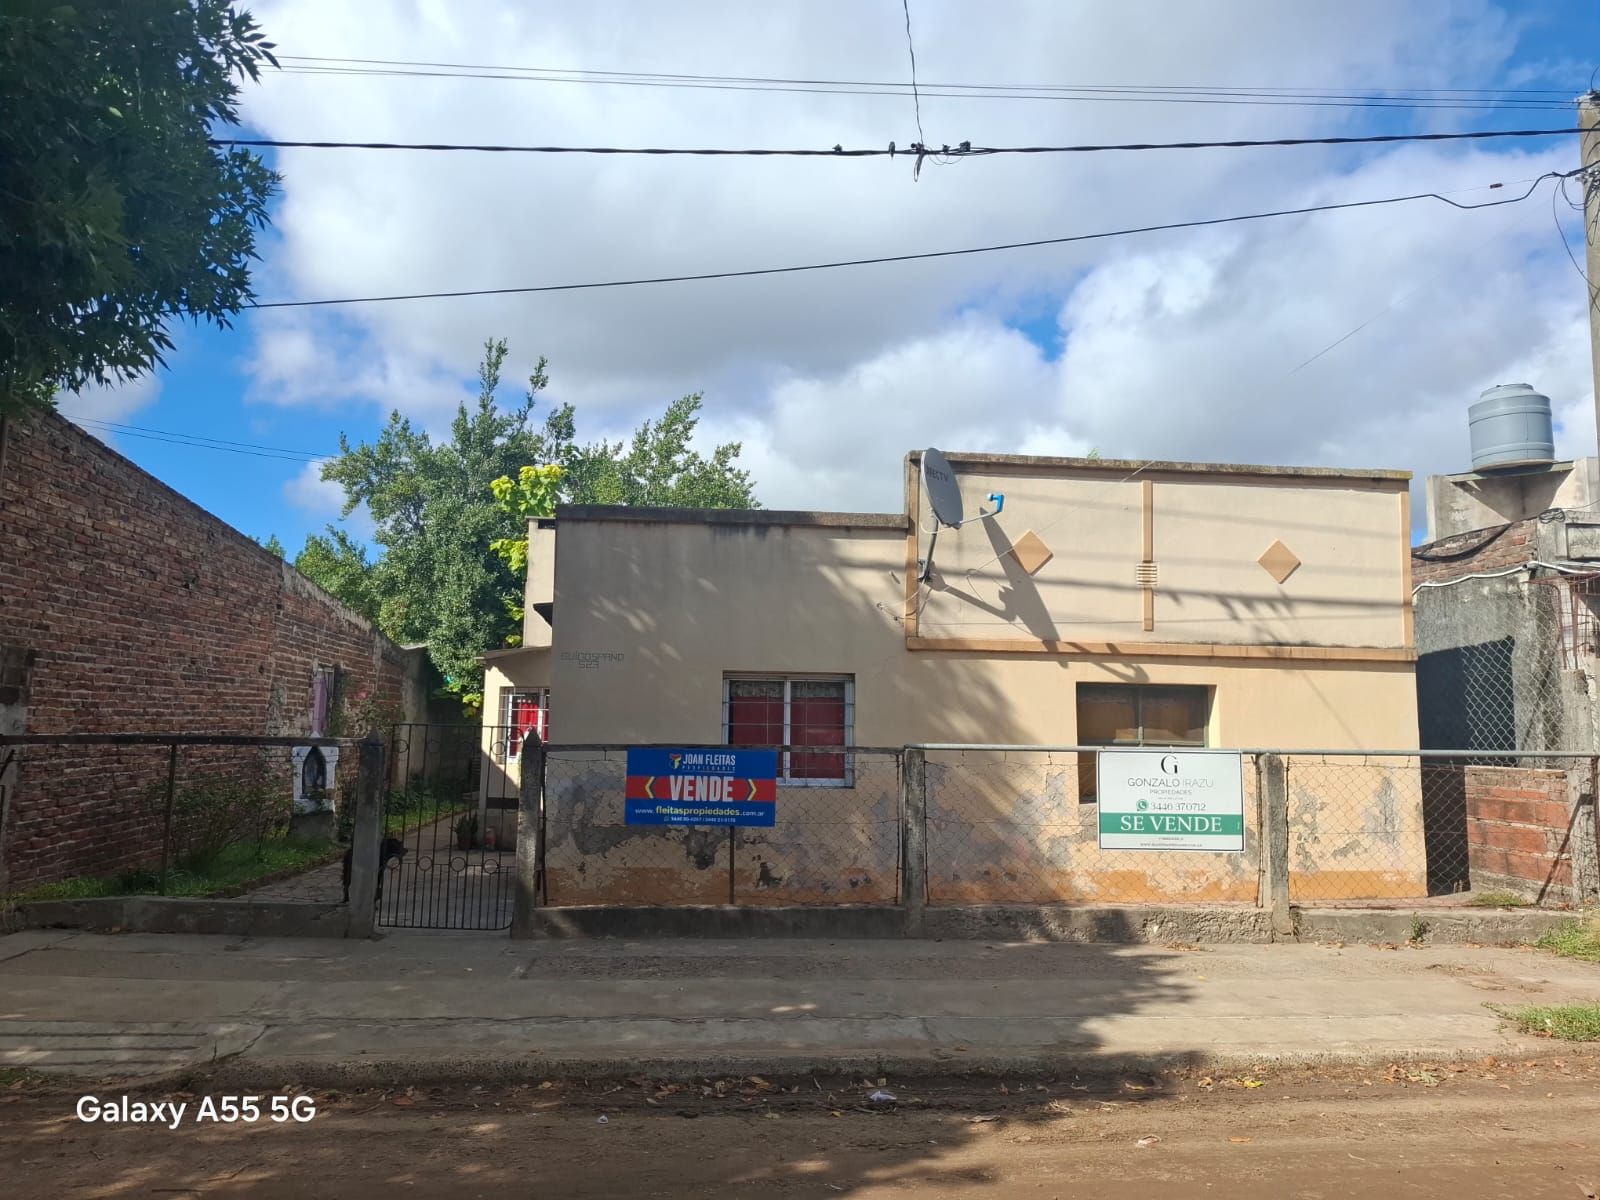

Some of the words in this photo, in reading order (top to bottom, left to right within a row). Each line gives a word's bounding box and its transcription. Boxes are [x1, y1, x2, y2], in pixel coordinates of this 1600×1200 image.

[682, 753, 703, 765] JOAN
[705, 753, 736, 766] FLEITAS
[669, 774, 735, 803] VENDE
[1127, 777, 1180, 788] GONZALO
[1182, 778, 1214, 788] IRAZU
[1175, 802, 1206, 812] 370712
[1120, 815, 1145, 831] SE
[1149, 816, 1223, 832] VENDE
